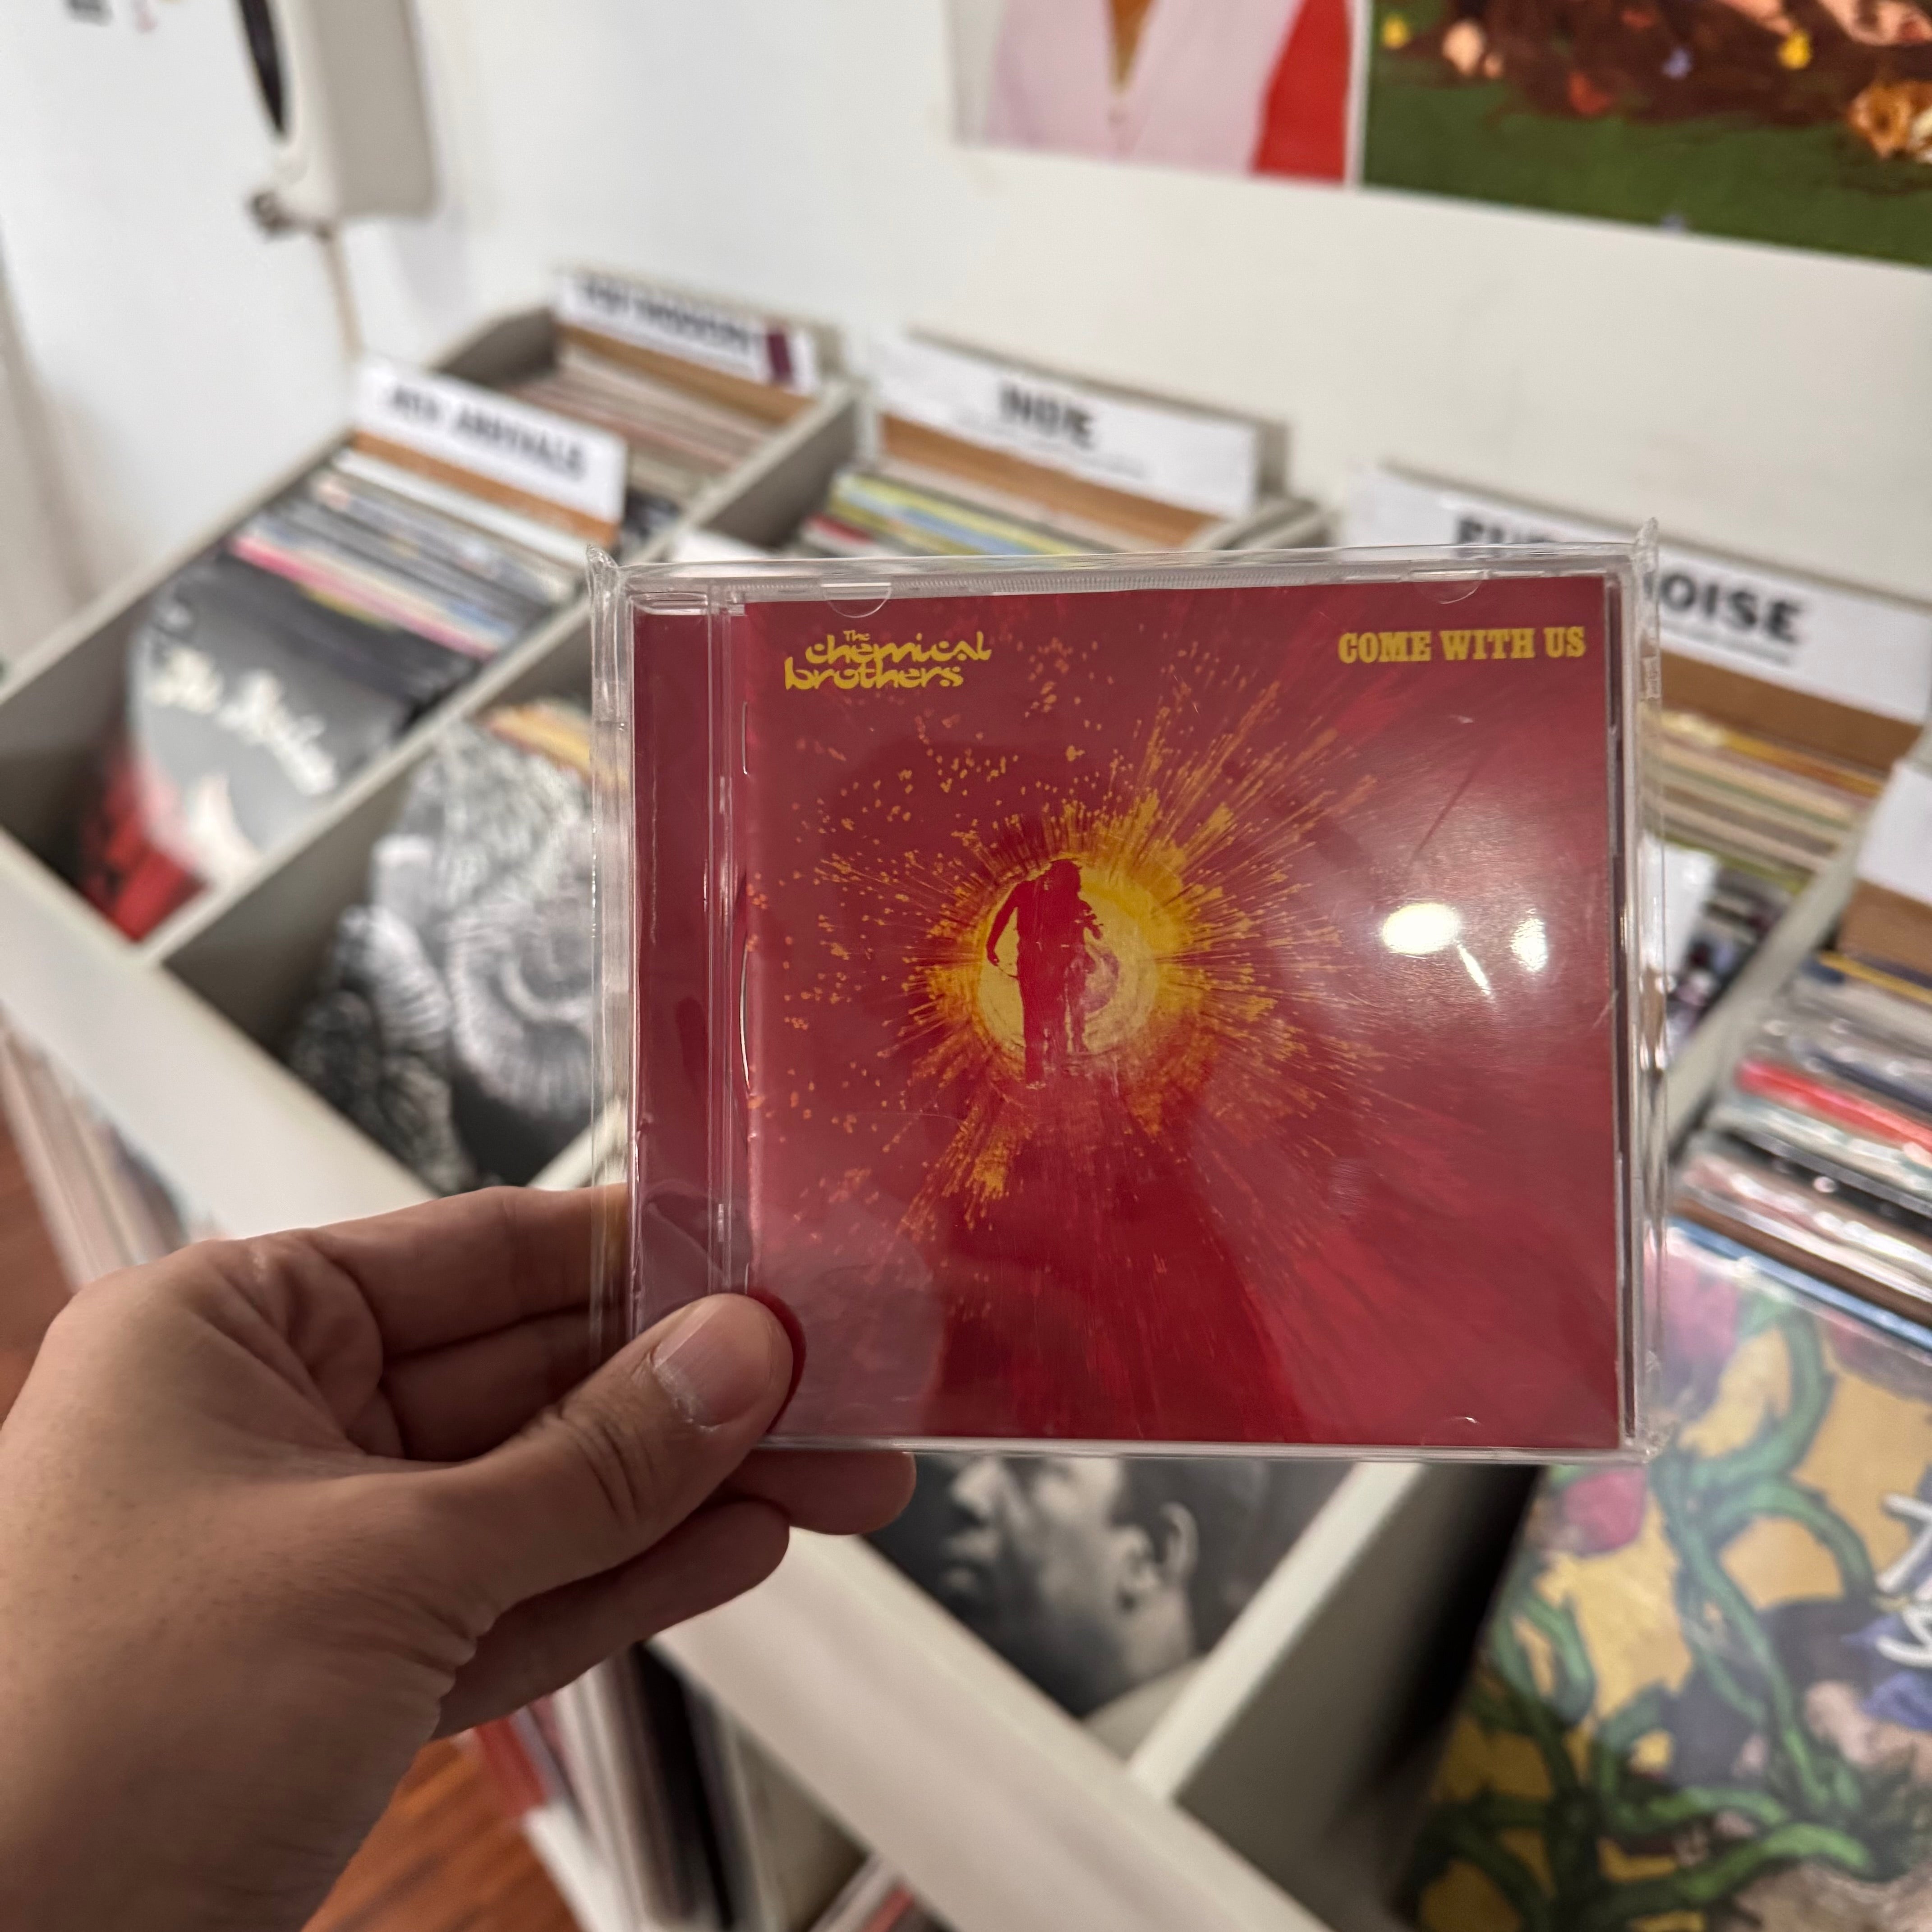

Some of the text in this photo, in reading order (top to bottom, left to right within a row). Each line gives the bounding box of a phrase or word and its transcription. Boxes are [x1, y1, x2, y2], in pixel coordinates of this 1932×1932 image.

[805, 631, 992, 664] chemical
[843, 630, 870, 641] The
[1338, 626, 1587, 663] COME WITH US
[784, 656, 964, 690] brothers
